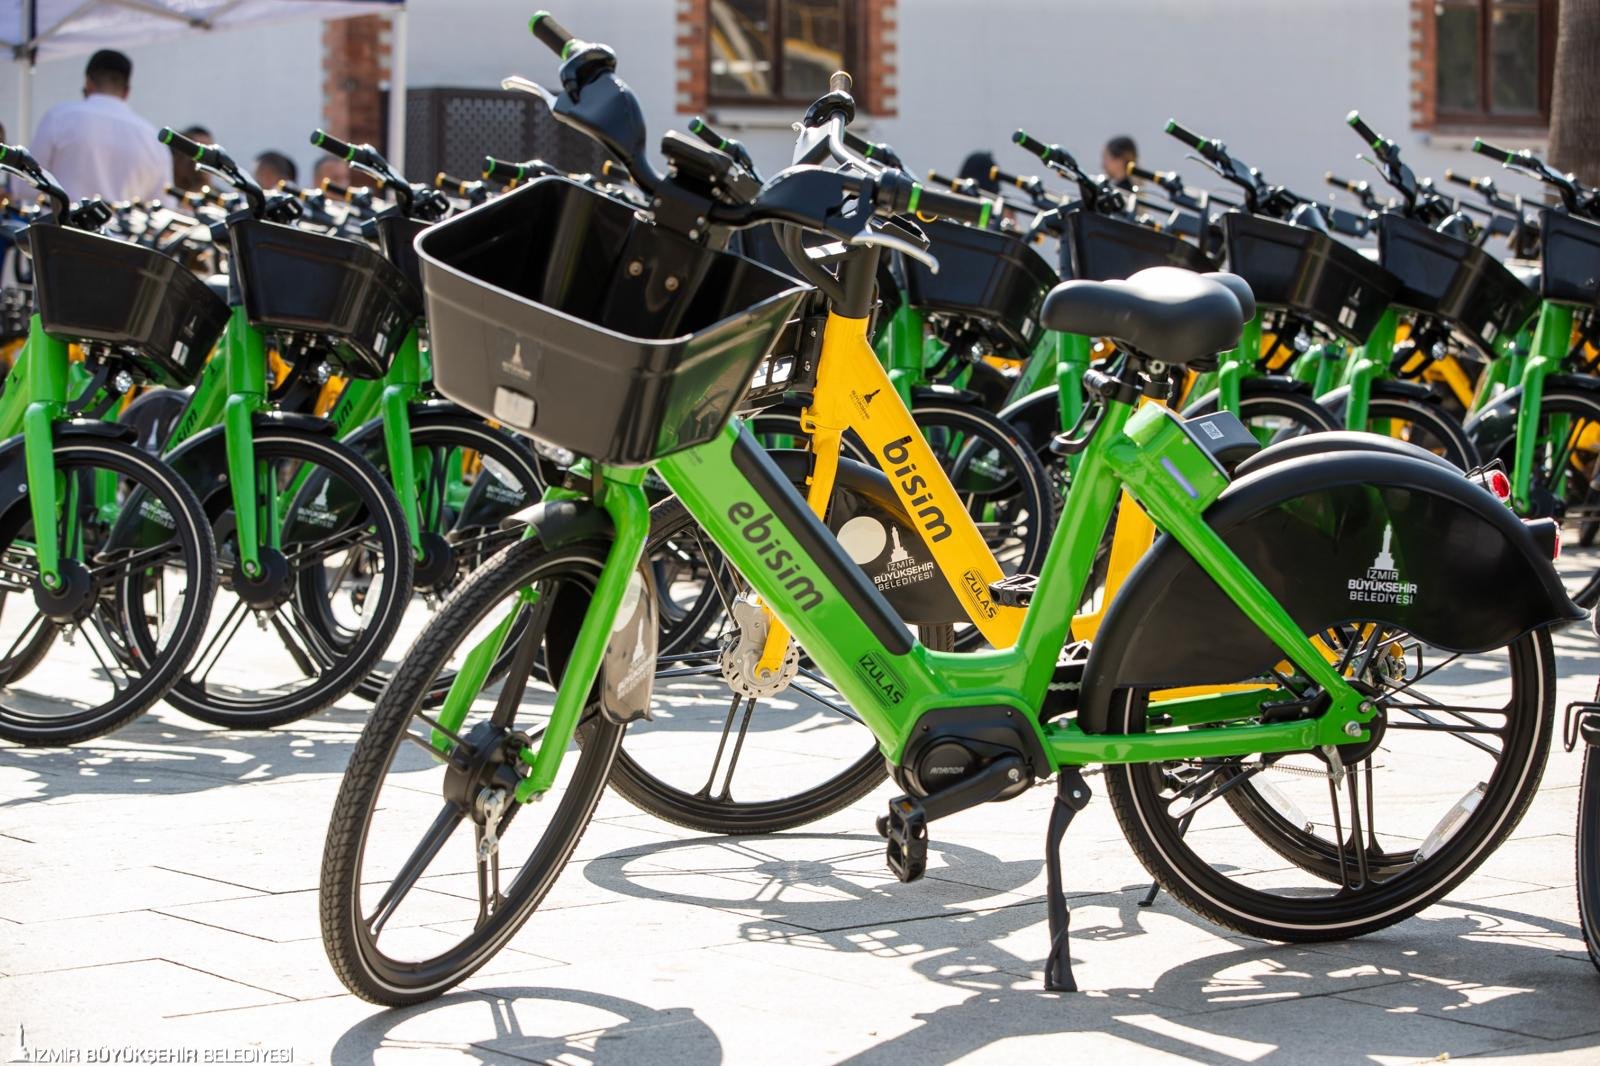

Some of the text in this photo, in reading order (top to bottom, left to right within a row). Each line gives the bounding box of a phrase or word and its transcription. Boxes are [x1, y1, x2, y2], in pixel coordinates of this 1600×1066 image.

[882, 435, 953, 543] bisim
[727, 501, 824, 612] ebisim
[1349, 591, 1413, 605] BELEDİYESİ
